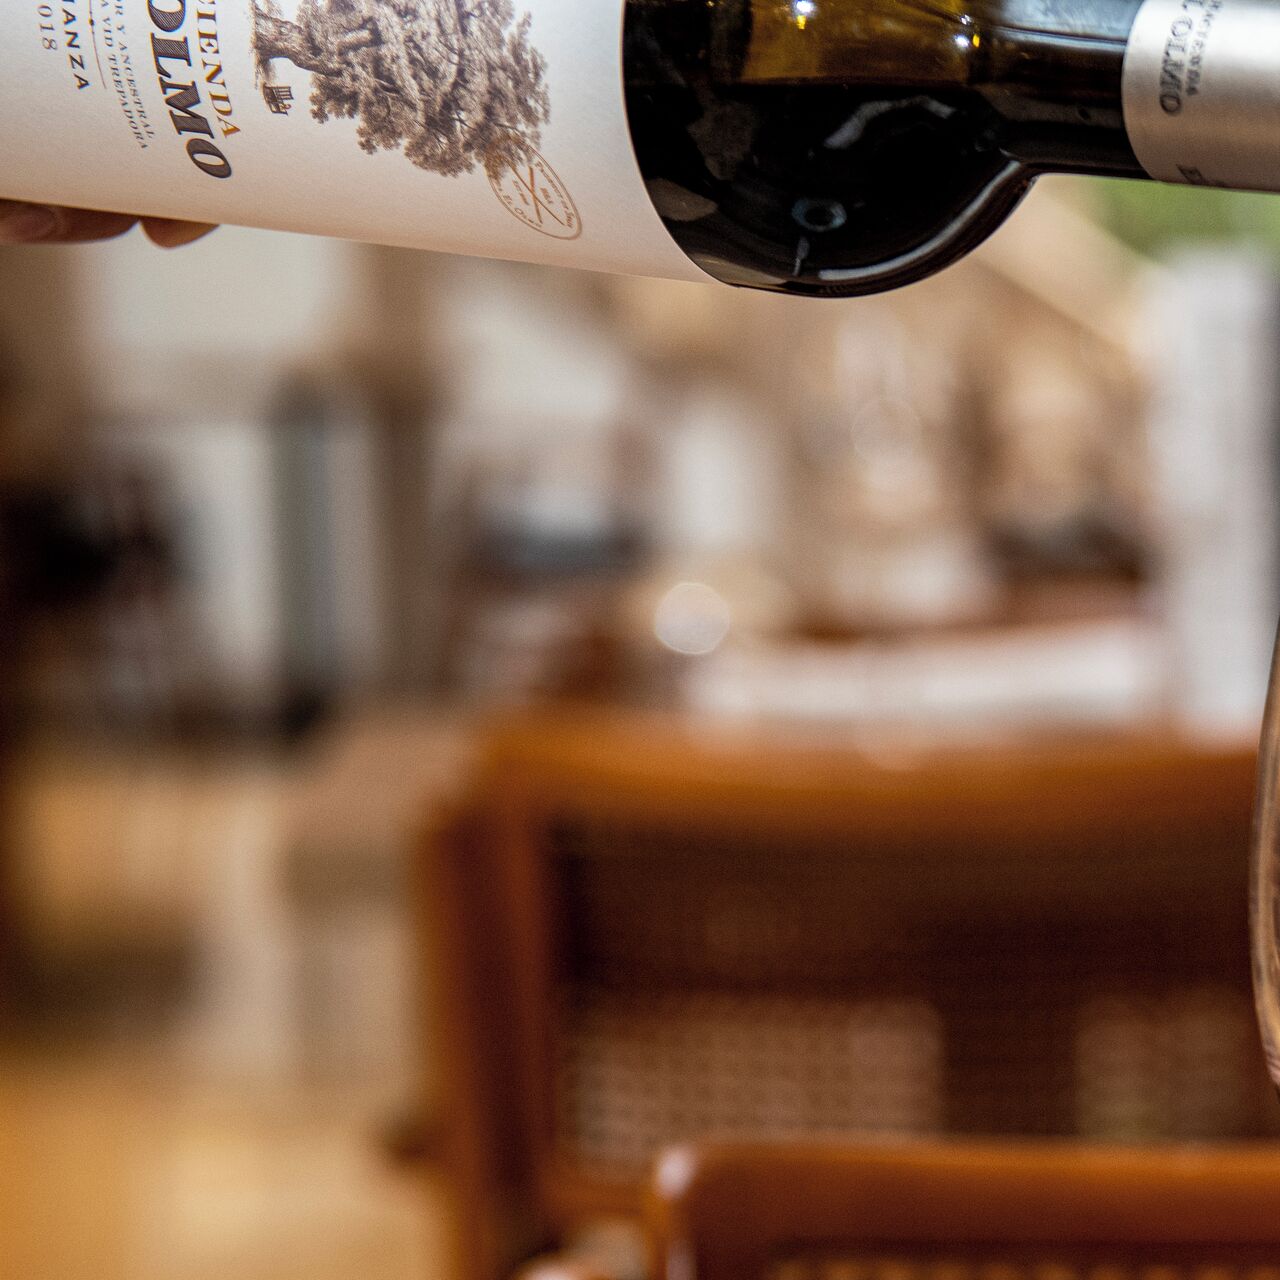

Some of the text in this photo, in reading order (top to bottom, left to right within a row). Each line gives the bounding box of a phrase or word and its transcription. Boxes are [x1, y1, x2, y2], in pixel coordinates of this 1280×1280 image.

[102, 17, 114, 48] VID
[108, 54, 148, 149] TREPADORA
[119, 41, 155, 138] ANCESTRAL
[197, 0, 241, 138] IENDA
